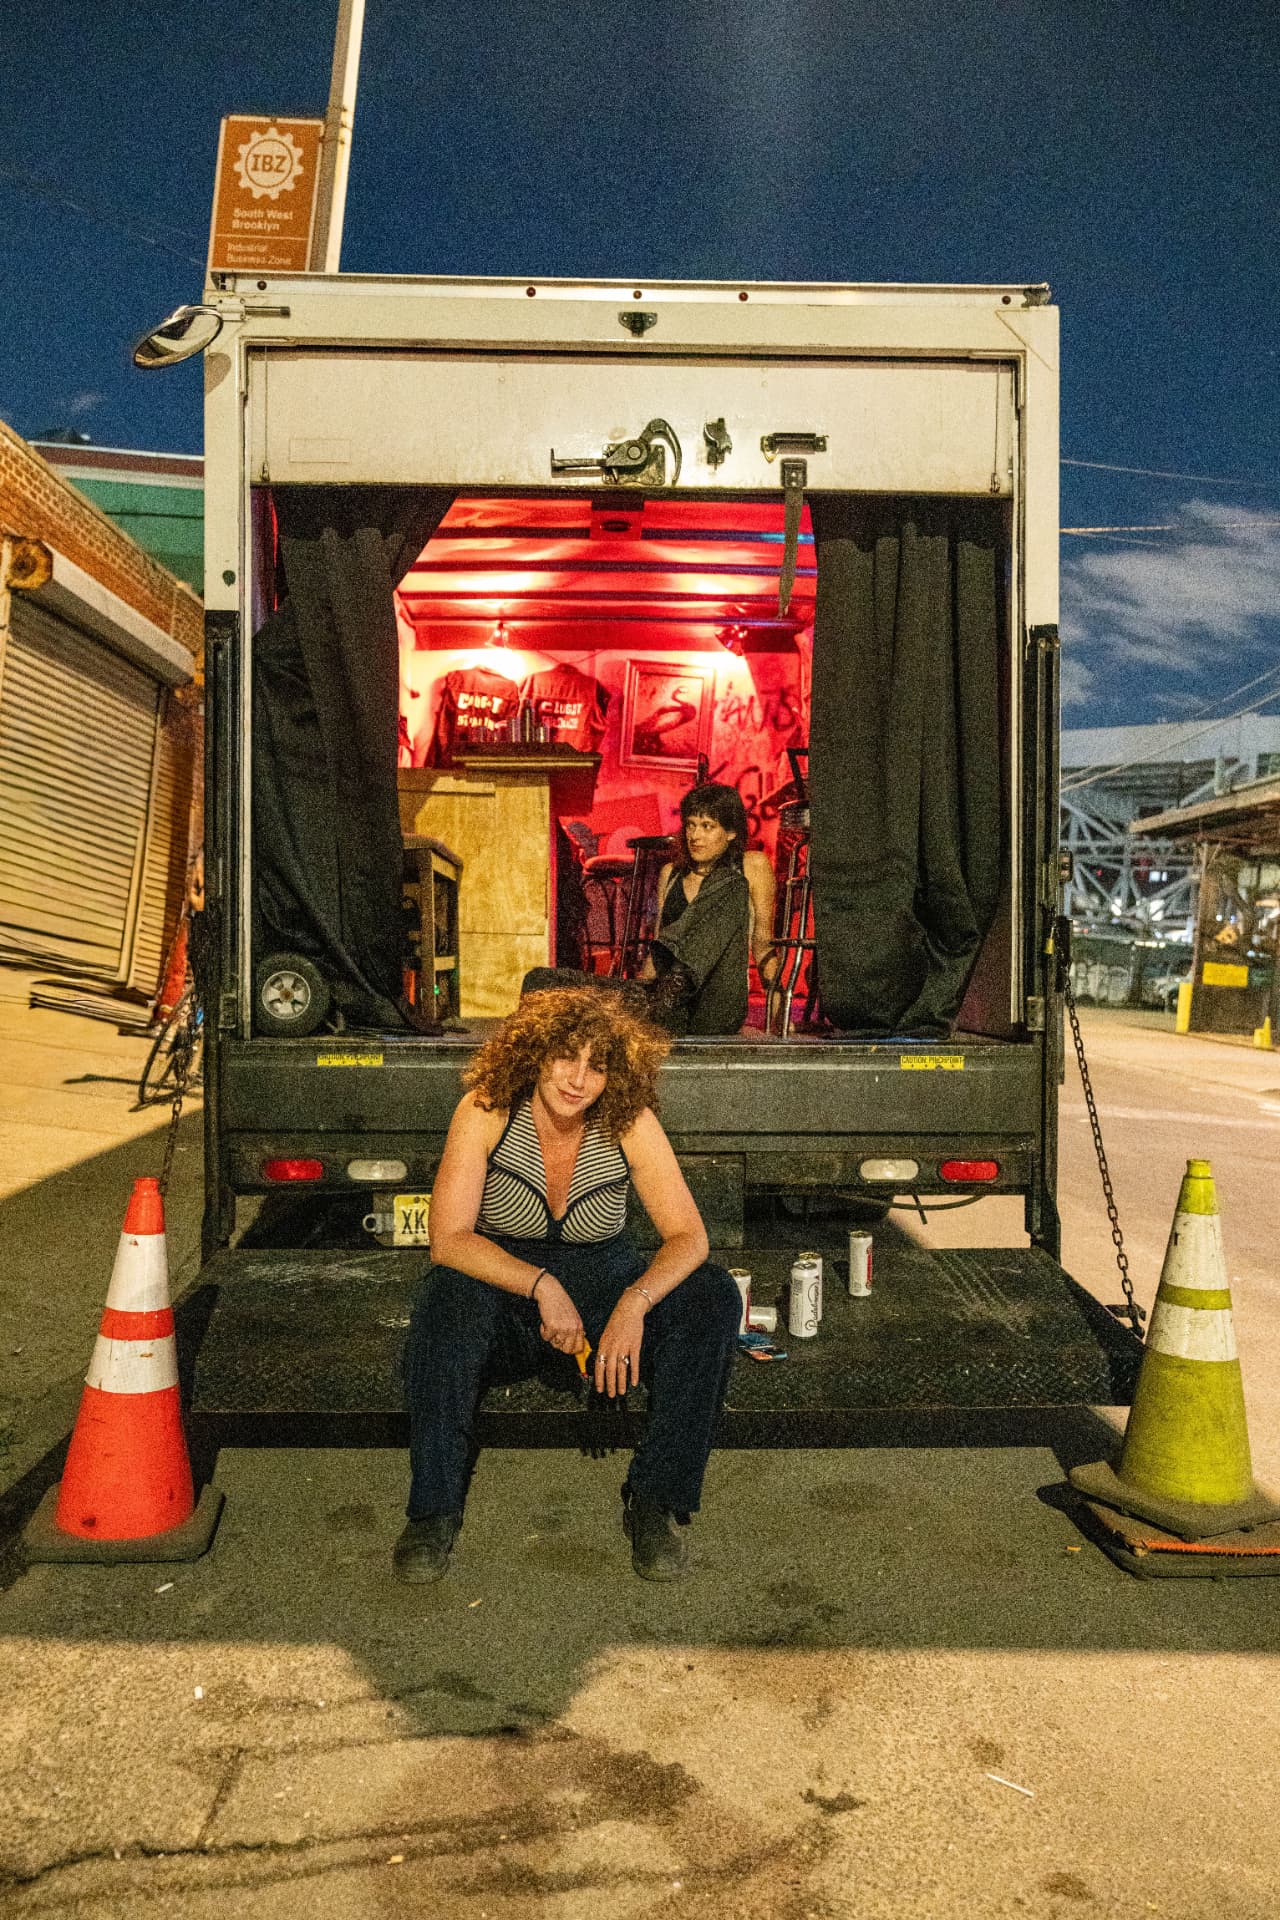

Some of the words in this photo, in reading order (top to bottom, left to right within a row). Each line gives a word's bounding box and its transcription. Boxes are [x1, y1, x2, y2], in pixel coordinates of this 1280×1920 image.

[251, 154, 287, 173] IBZ
[233, 208, 264, 218] South
[267, 209, 293, 220] West
[232, 219, 280, 231] Brooklyn
